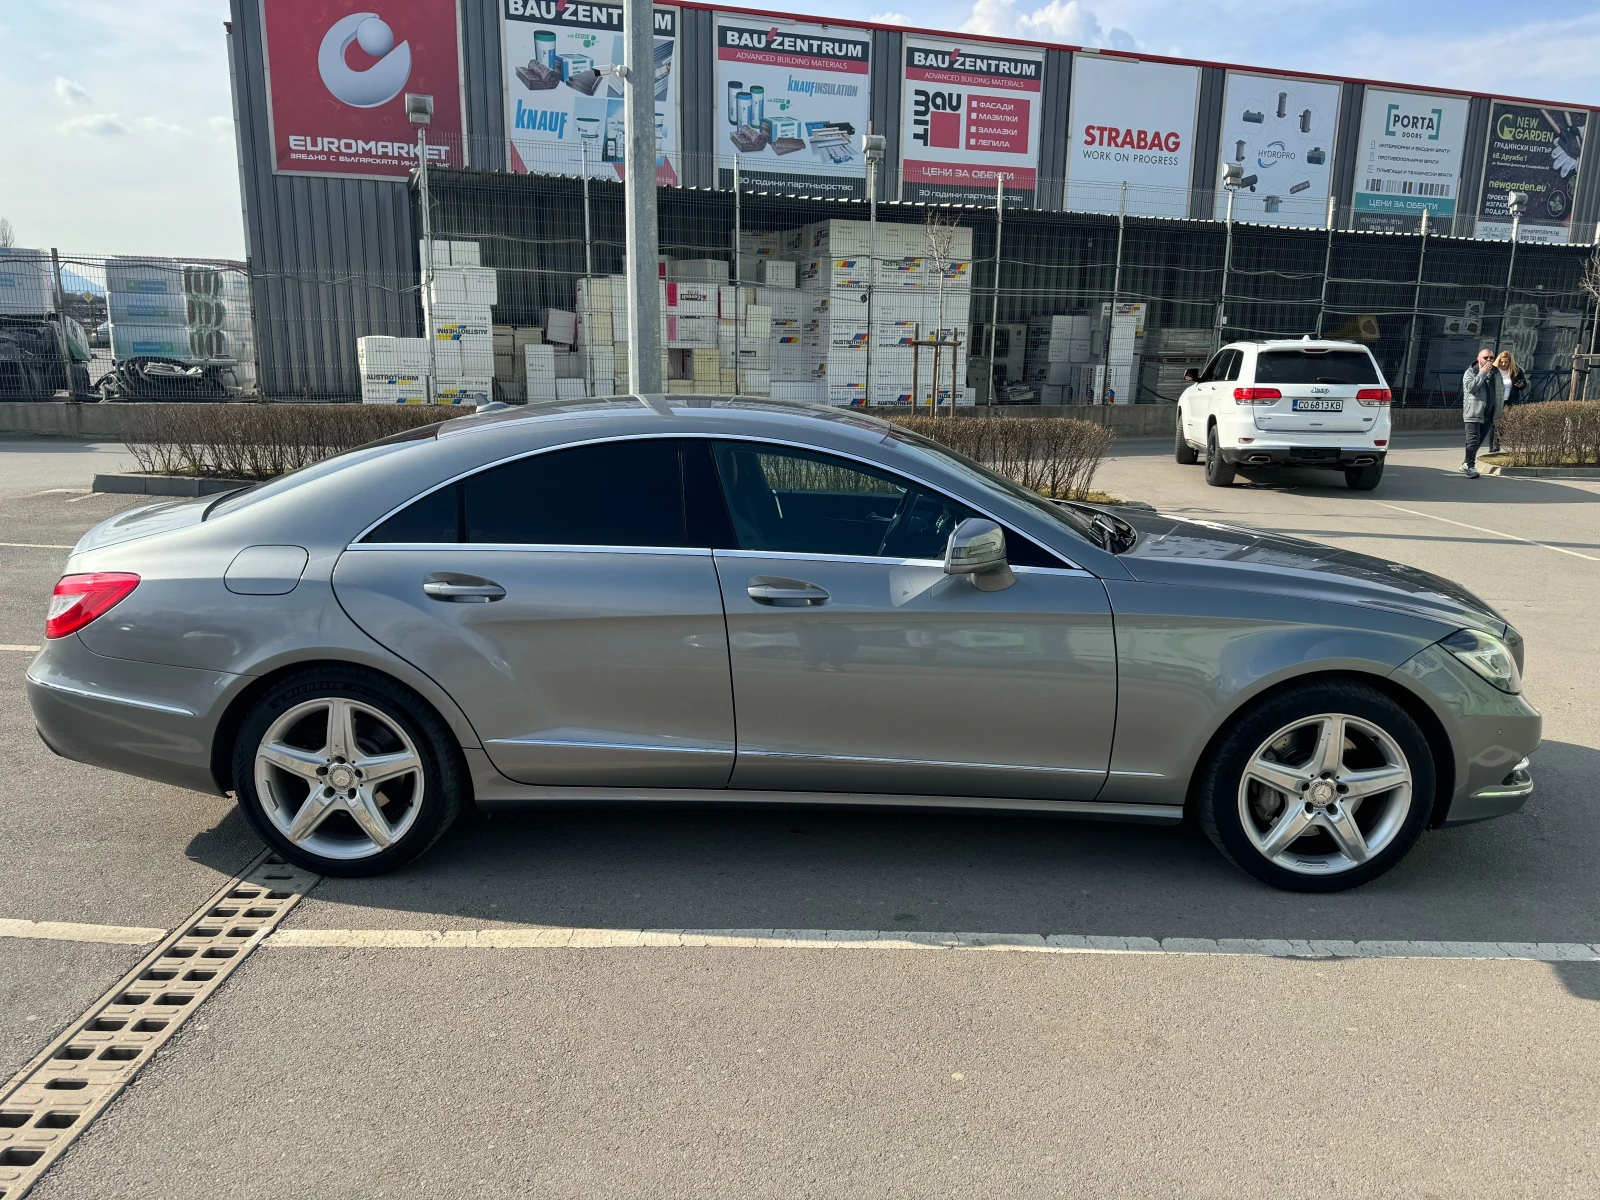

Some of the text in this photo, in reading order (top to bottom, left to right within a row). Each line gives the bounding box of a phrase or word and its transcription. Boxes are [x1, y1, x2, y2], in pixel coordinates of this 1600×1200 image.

[736, 51, 848, 70] ADVANCED BUILDING MATERIALS
[924, 72, 1025, 88] ADVANCED BUILDING MATERIALS
[979, 101, 1014, 111] ФАСАДИ
[978, 113, 1018, 123] МАЗИЛКИ
[1392, 113, 1435, 131] PORTA
[1516, 116, 1539, 129] NEW
[977, 126, 1018, 136] ЗАМАЗКИ
[1401, 131, 1423, 139] DOORS
[1515, 128, 1554, 143] GARDEN
[977, 139, 1010, 148] ЛЕПИЛА
[1083, 124, 1181, 153] STRABAG
[289, 135, 450, 160] EUROMARKET
[1493, 142, 1552, 154] ГРАДИНСКИ ЦЕНТЪР
[1082, 150, 1179, 166] WORK ON PROGRESS
[1257, 150, 1296, 160] HYDROPRO
[922, 166, 1015, 181] ЦЕНИ ЗА ОБЕКТИ
[751, 178, 786, 188] години
[787, 180, 854, 191] партньорство
[1488, 180, 1547, 193] newgarden.eu
[918, 189, 1023, 202] 30 години партньоство
[1368, 198, 1438, 210] ЦЕНИ ЗА ОБЕКТИ
[1310, 387, 1330, 395] Jeep
[284, 681, 345, 701] MICHELIN
